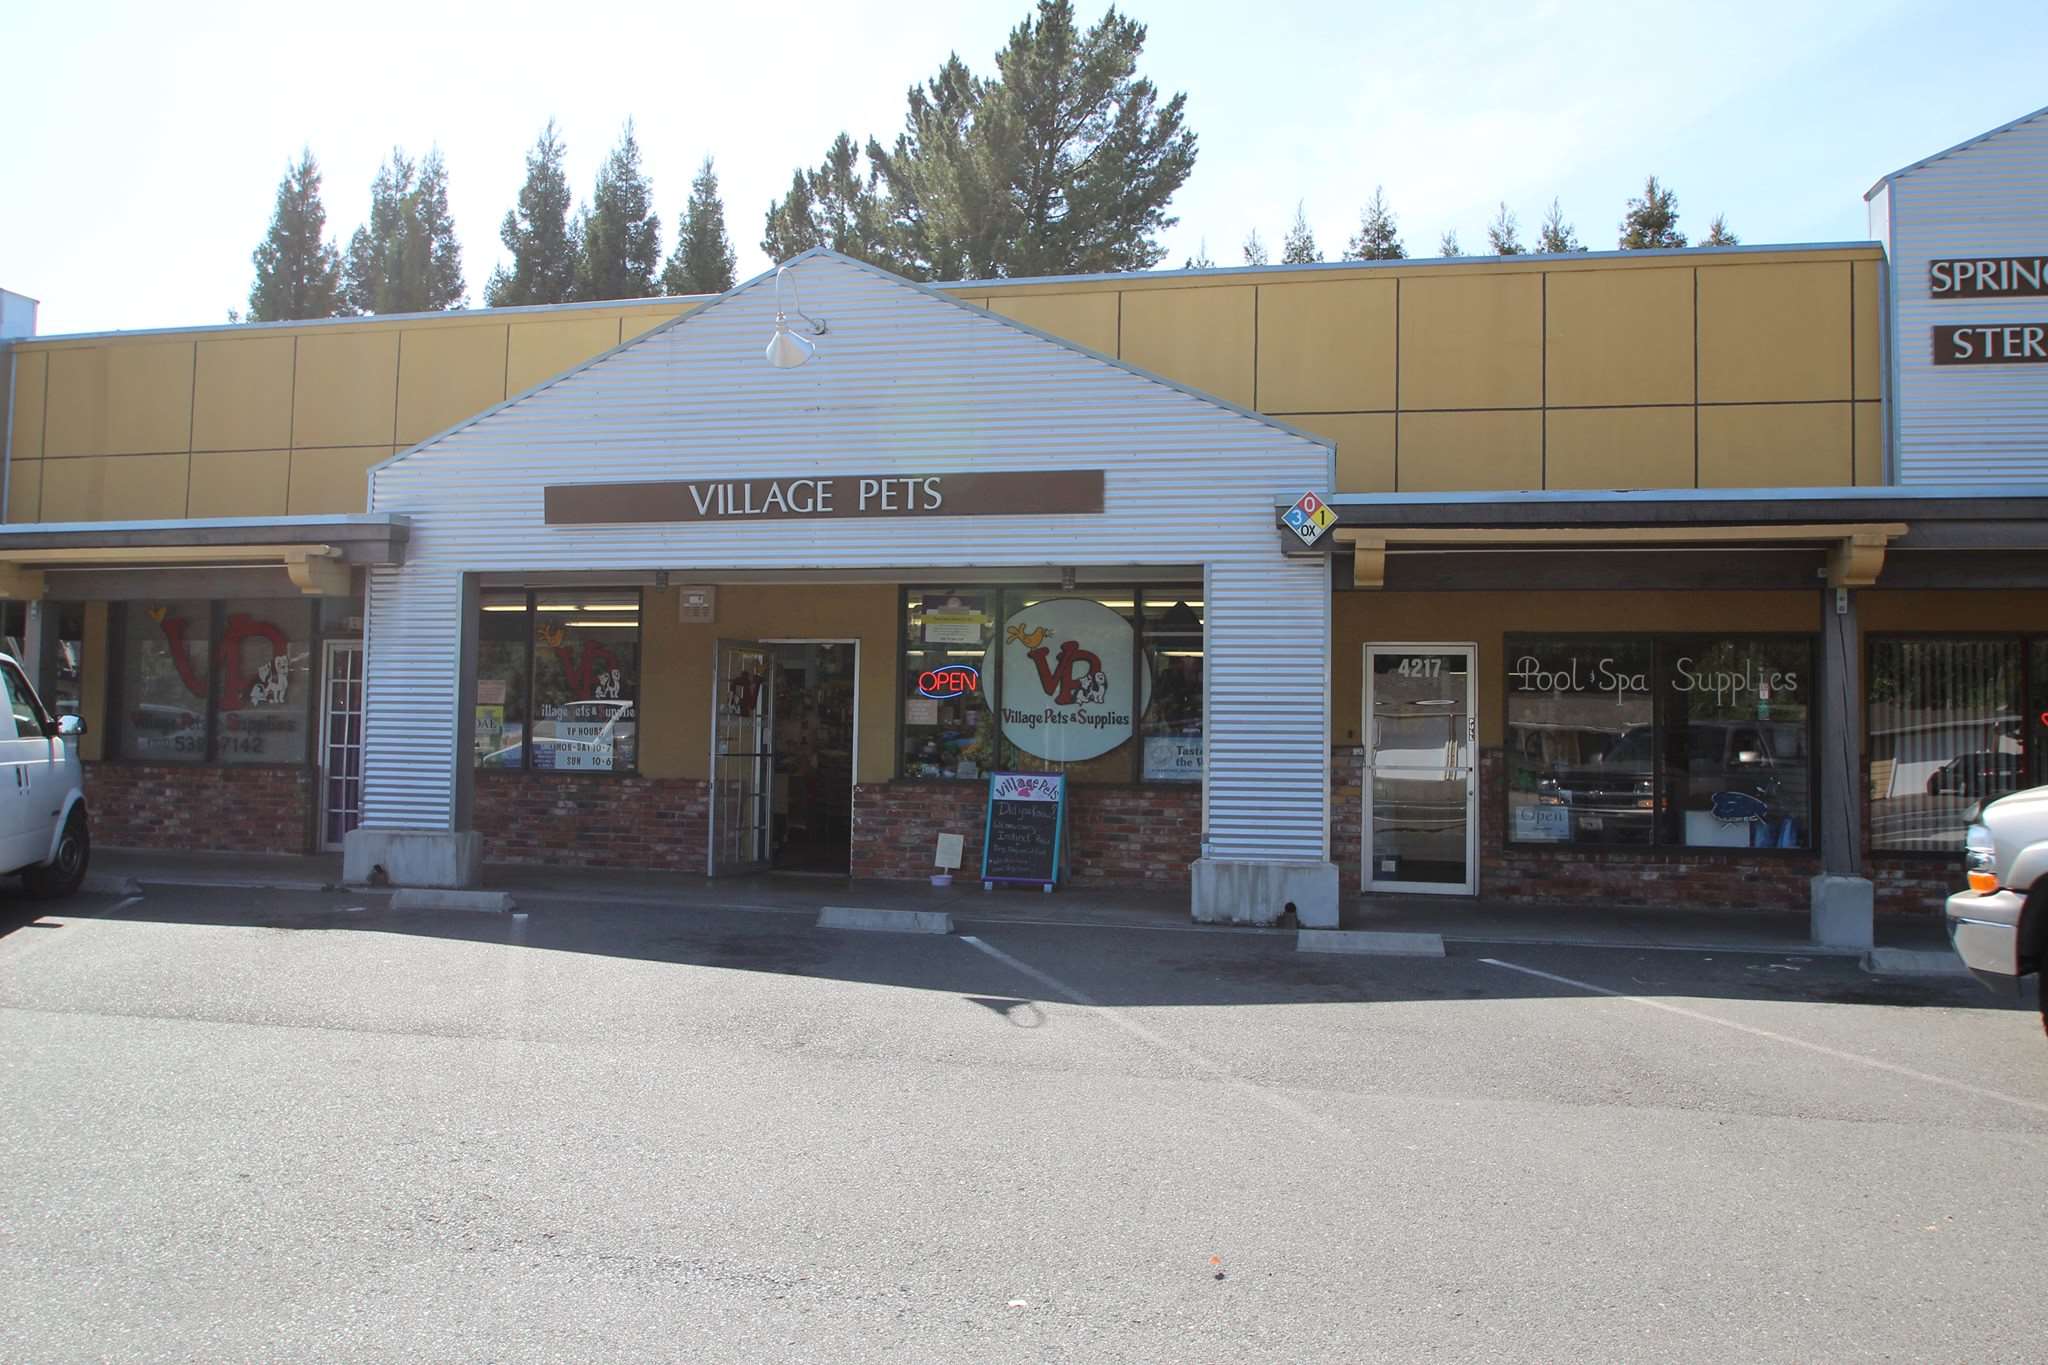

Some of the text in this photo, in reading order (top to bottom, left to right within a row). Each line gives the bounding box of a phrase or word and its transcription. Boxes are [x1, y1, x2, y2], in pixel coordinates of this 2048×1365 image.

[1931, 261, 2048, 292] SPRIN
[1952, 326, 2048, 360] STER
[688, 476, 943, 516] VILLAGE PETS
[1290, 508, 1303, 526] 3
[1319, 509, 1327, 526] 1
[1300, 524, 1316, 538] OX
[1397, 657, 1442, 680] 4217
[918, 671, 977, 692] OPEN
[1515, 655, 1585, 692] Pool
[1598, 657, 1650, 706] Spa
[1671, 657, 1799, 707] Supplies
[1002, 708, 1044, 728] Village
[1044, 707, 1071, 725] Pets
[1077, 707, 1129, 729] Supplies
[577, 726, 603, 737] HOURS
[566, 756, 582, 767] SUN
[995, 777, 1060, 801] Village Pets
